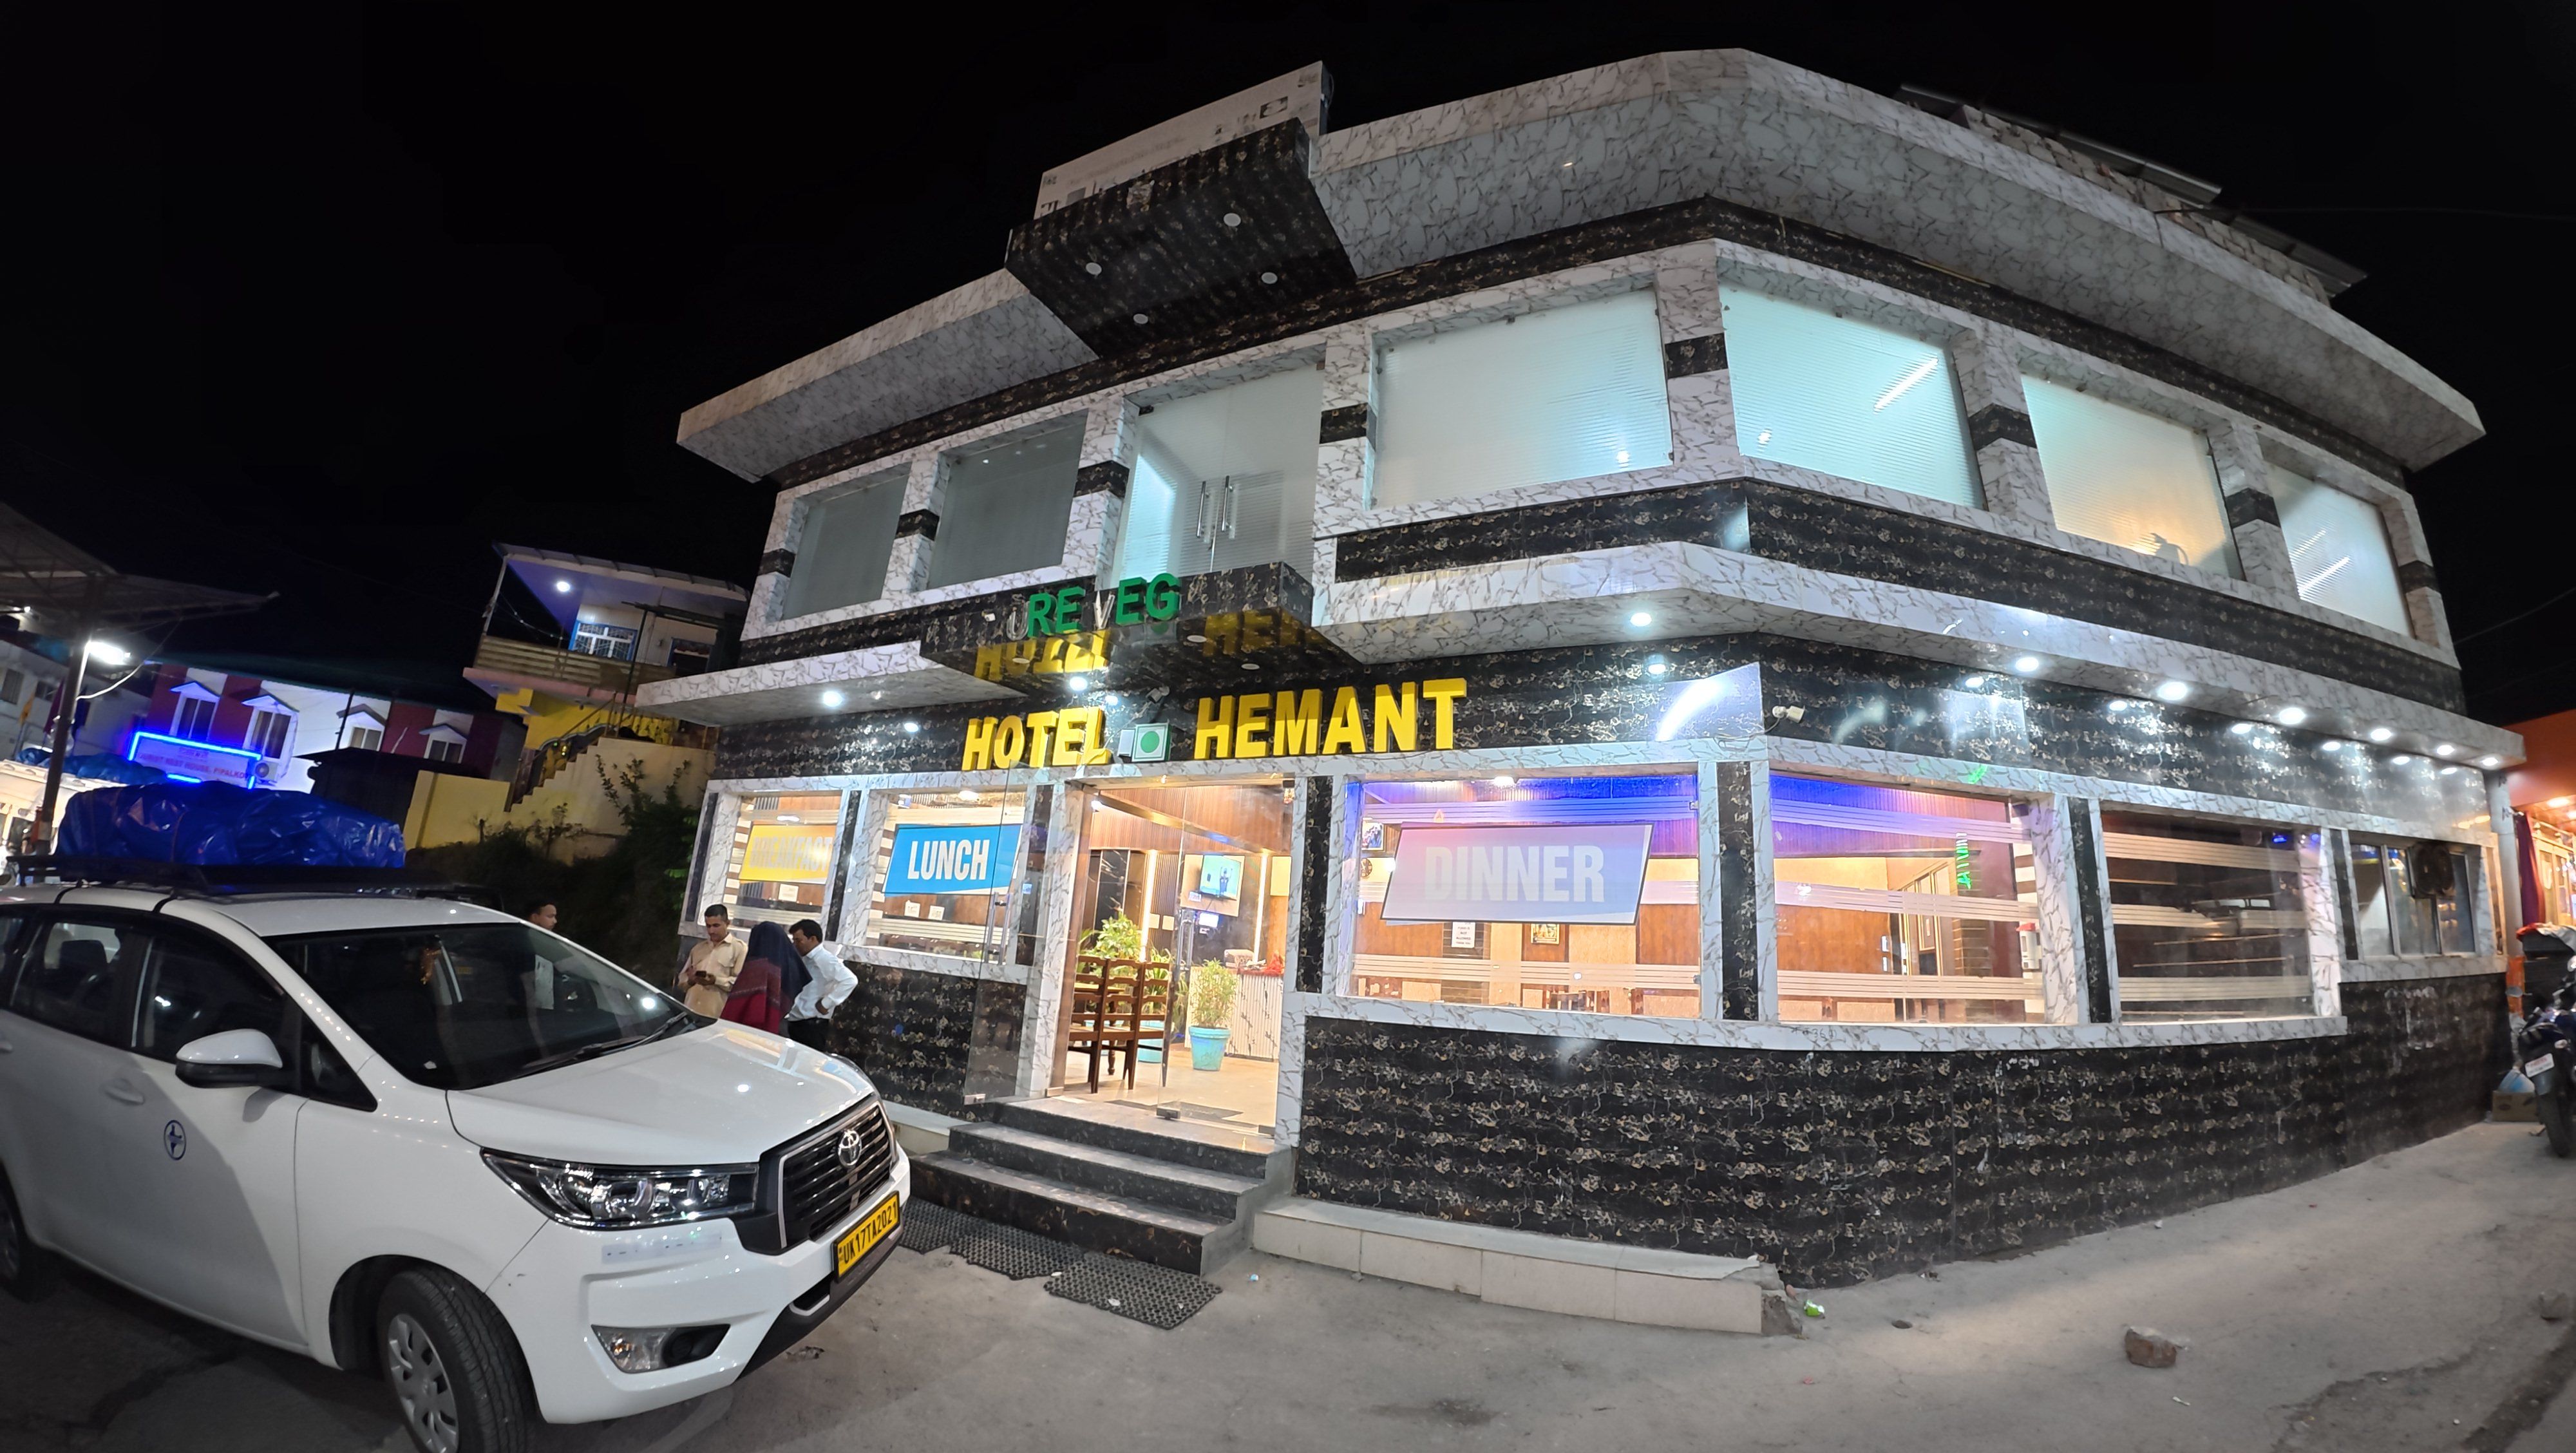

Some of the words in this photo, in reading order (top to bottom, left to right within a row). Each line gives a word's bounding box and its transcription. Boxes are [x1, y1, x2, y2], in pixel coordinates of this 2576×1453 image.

[1094, 573, 1180, 629] VEG
[961, 707, 1111, 771] HOTEL
[1194, 678, 1467, 759] HEMANT
[749, 836, 833, 872] BREAKFAST
[907, 839, 990, 880] LUNCH
[1425, 846, 1605, 902] DINNER
[843, 1201, 897, 1264] UK17TA2021
